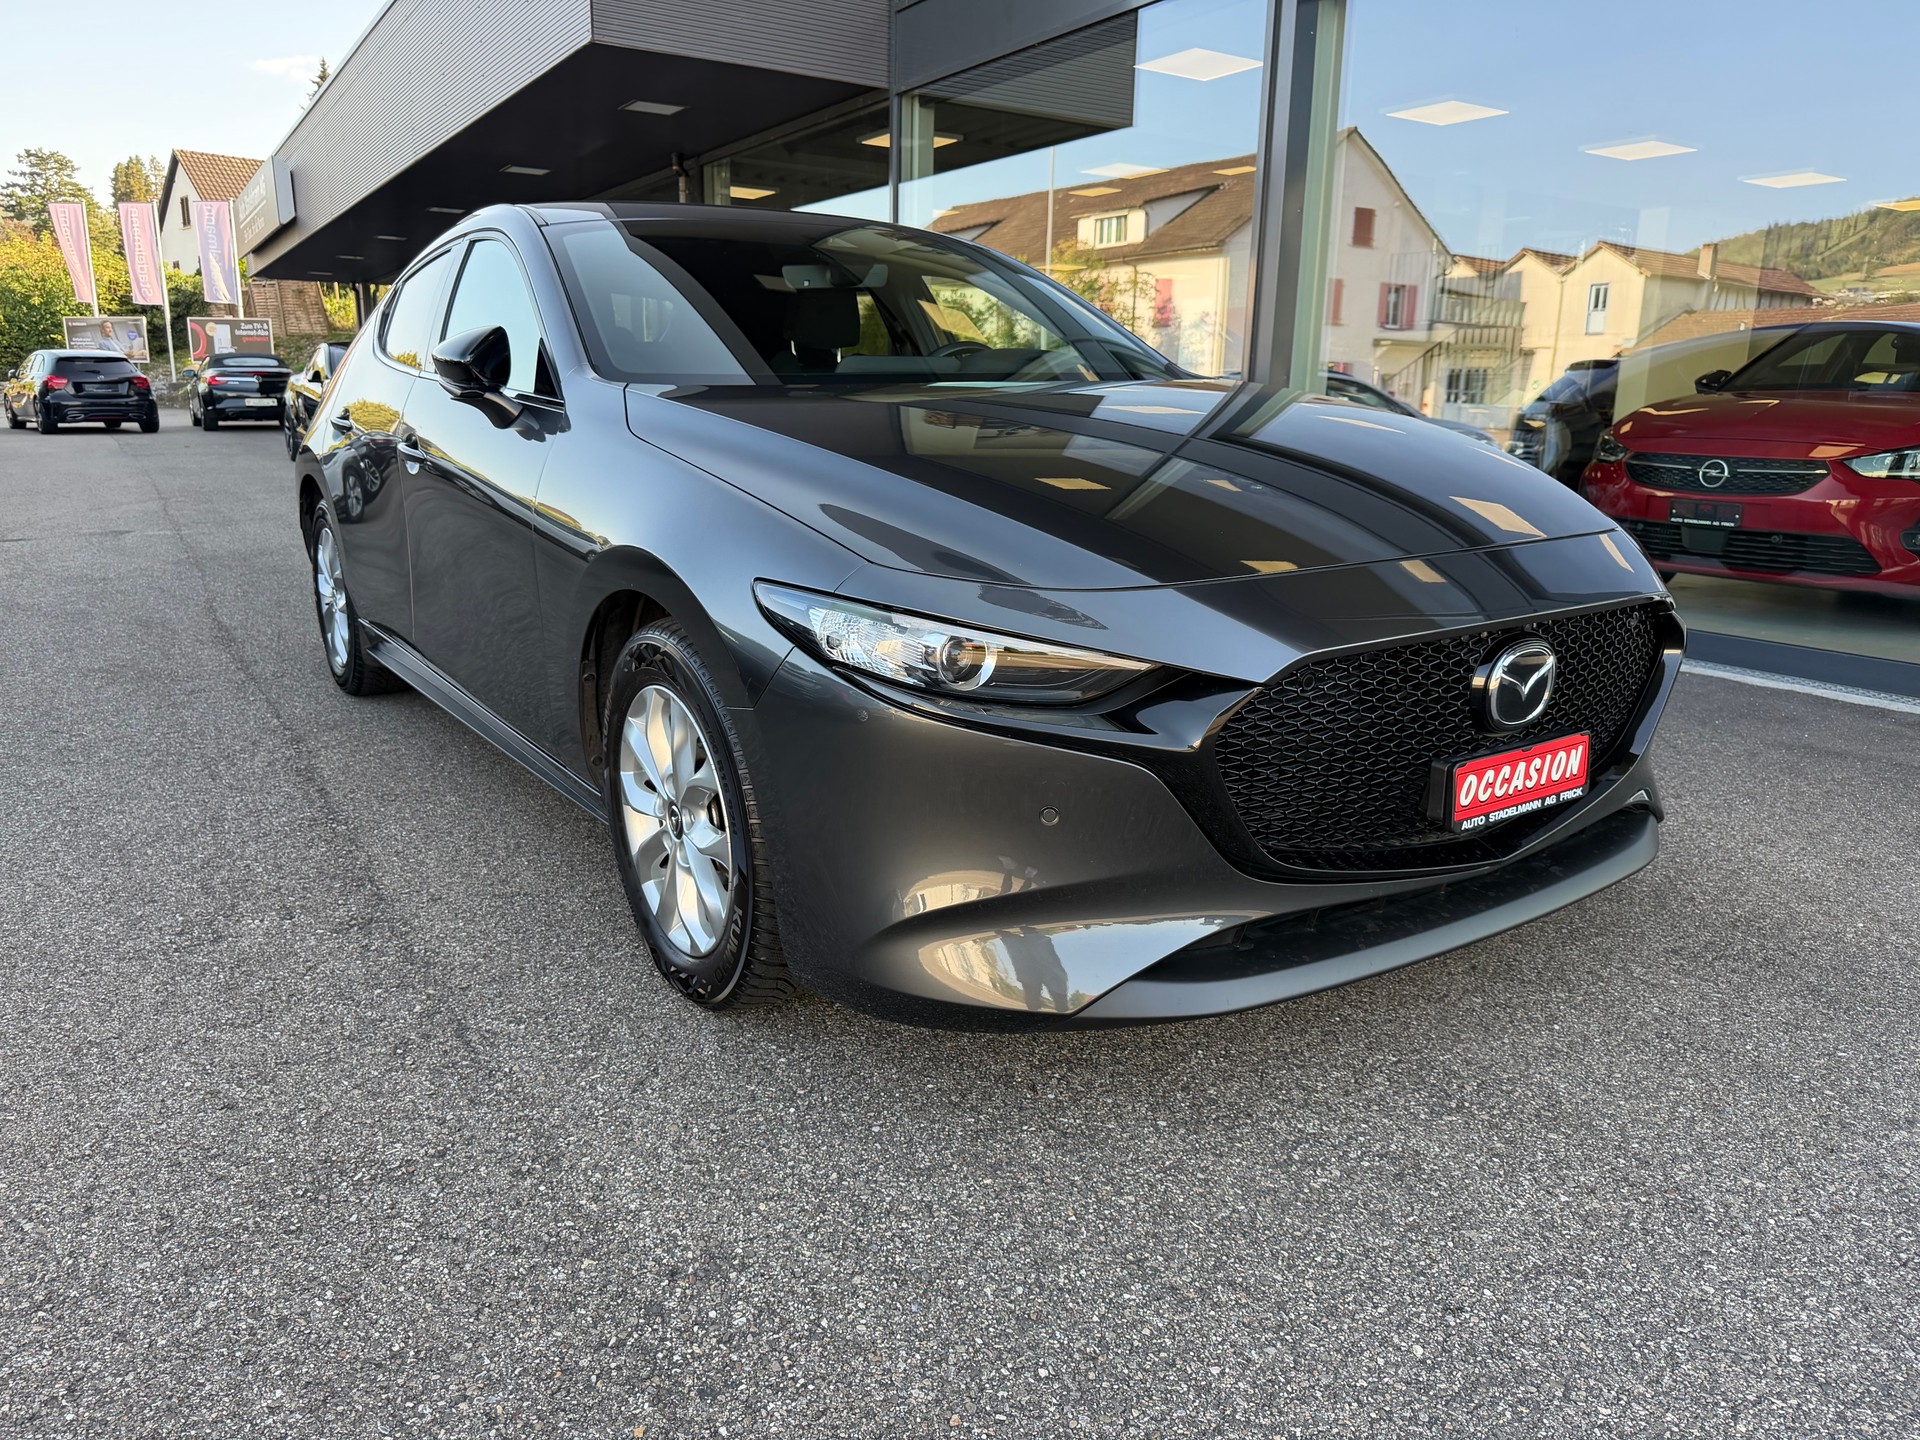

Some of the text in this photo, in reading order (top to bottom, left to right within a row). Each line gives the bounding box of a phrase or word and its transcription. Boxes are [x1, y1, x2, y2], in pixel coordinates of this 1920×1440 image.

[1459, 745, 1583, 806] OCCASION
[1461, 787, 1583, 830] AUTO STADELMANN AG FRICK
